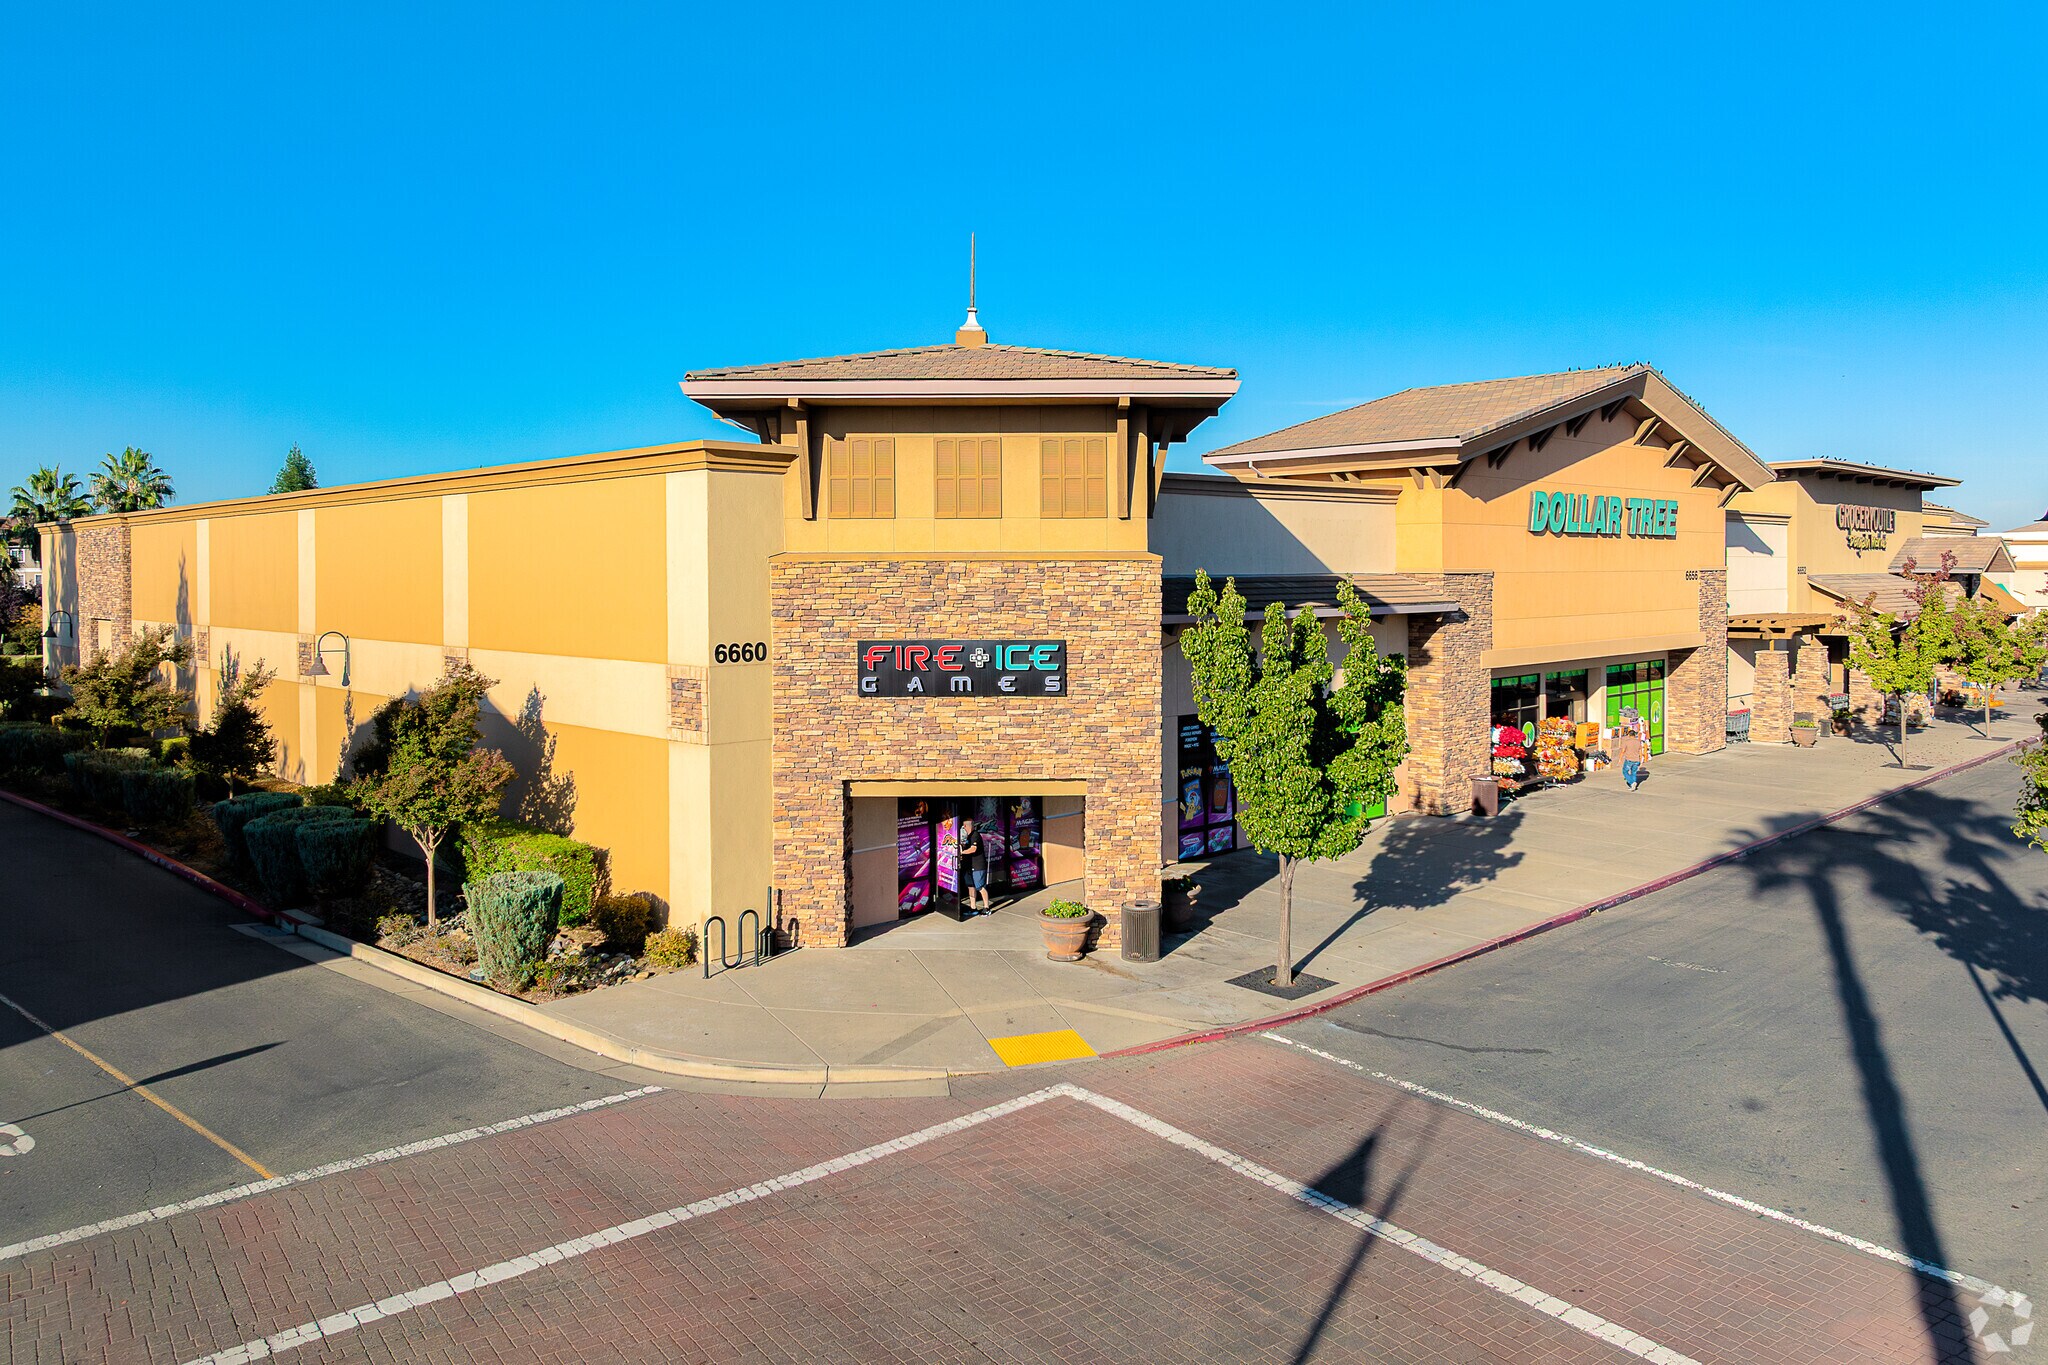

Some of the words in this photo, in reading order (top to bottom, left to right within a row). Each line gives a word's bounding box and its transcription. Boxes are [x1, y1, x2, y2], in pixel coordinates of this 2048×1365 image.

[1528, 490, 1623, 538] DOLLAR
[1625, 497, 1678, 540] TREE
[1836, 504, 1875, 532] GROCERY
[714, 641, 768, 664] 6660
[863, 644, 965, 672] FIRE
[995, 644, 1060, 672] ICE
[861, 675, 1062, 693] GAMES
